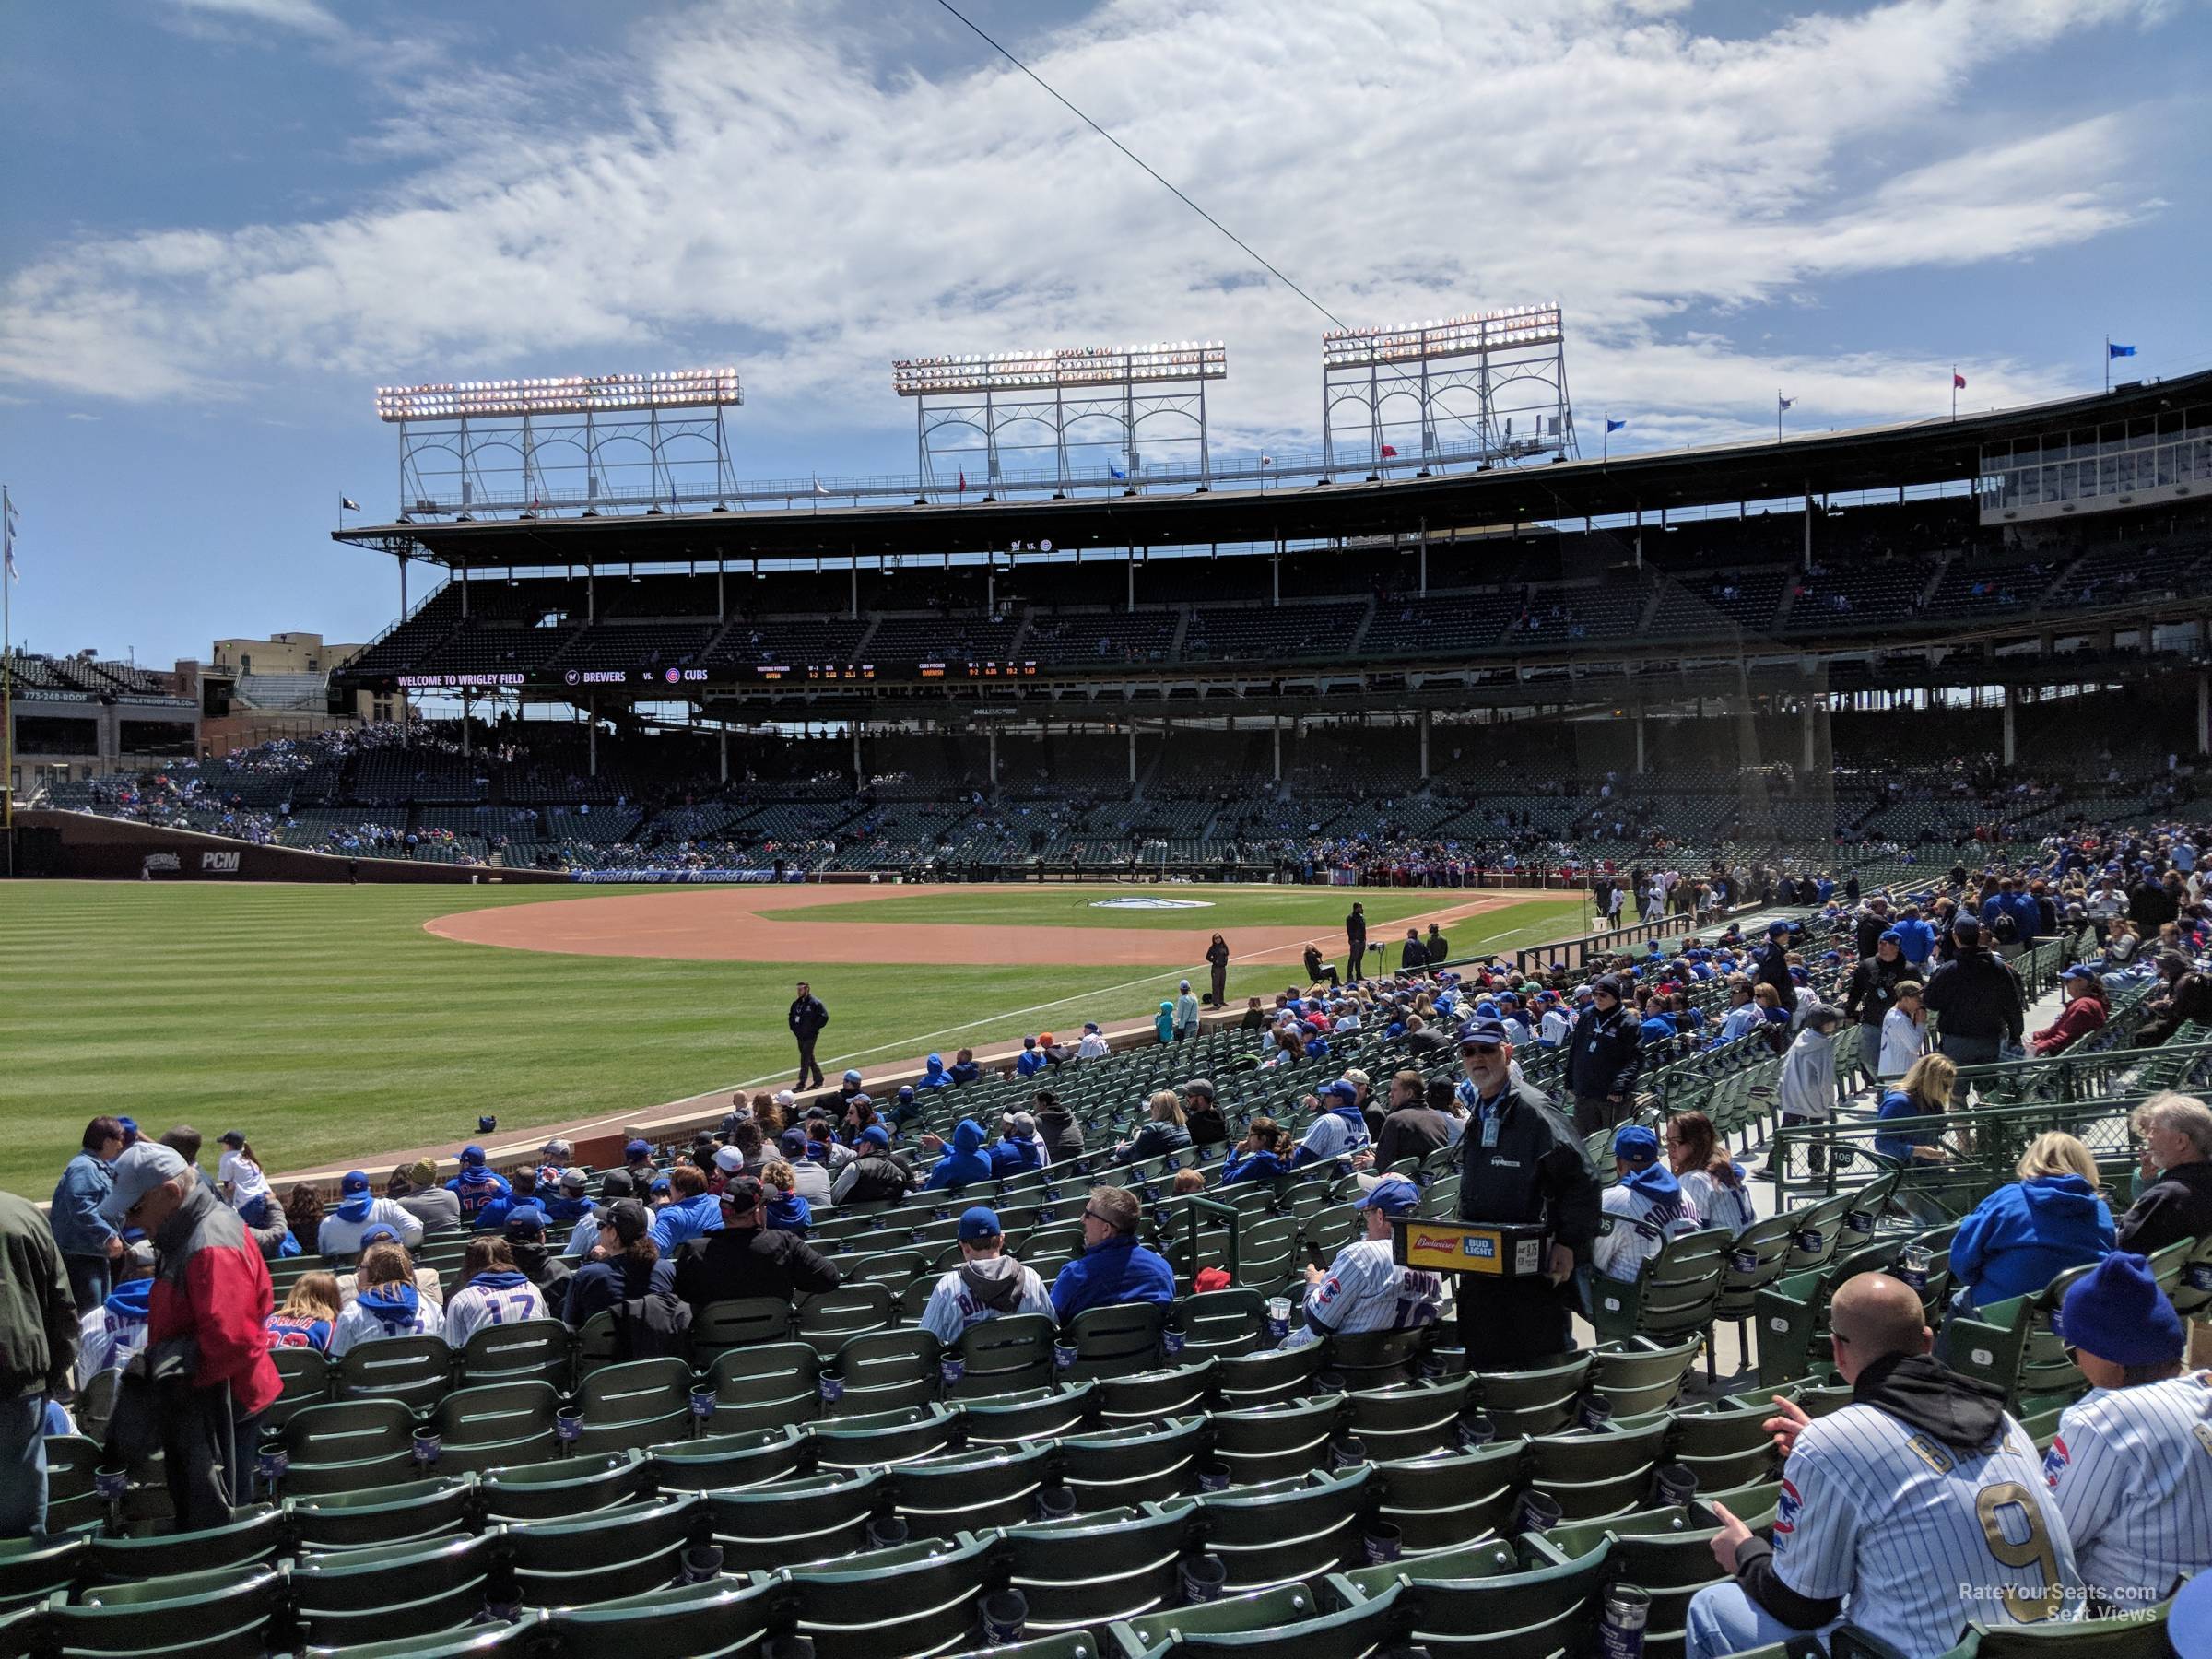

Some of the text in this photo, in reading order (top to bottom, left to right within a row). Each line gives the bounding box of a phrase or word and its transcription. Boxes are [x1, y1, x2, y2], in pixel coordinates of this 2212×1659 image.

[398, 674, 524, 687] WELCOME TO WRIGLEY FIELD
[583, 671, 626, 683] BREWERS
[684, 670, 708, 680] CUBS
[202, 852, 240, 869] PCM
[578, 871, 661, 883] Reynolds Wrap
[688, 871, 772, 883] Reynolds Wrap
[1834, 1152, 1851, 1163] 106
[1417, 1237, 1455, 1250] Budweiser
[1468, 1238, 1489, 1248] BUD
[1465, 1246, 1494, 1256] LIGHT
[486, 1294, 535, 1324] 17
[1777, 1320, 1783, 1329] 2
[1979, 1352, 1985, 1362] 3
[1976, 1481, 2064, 1624] 9
